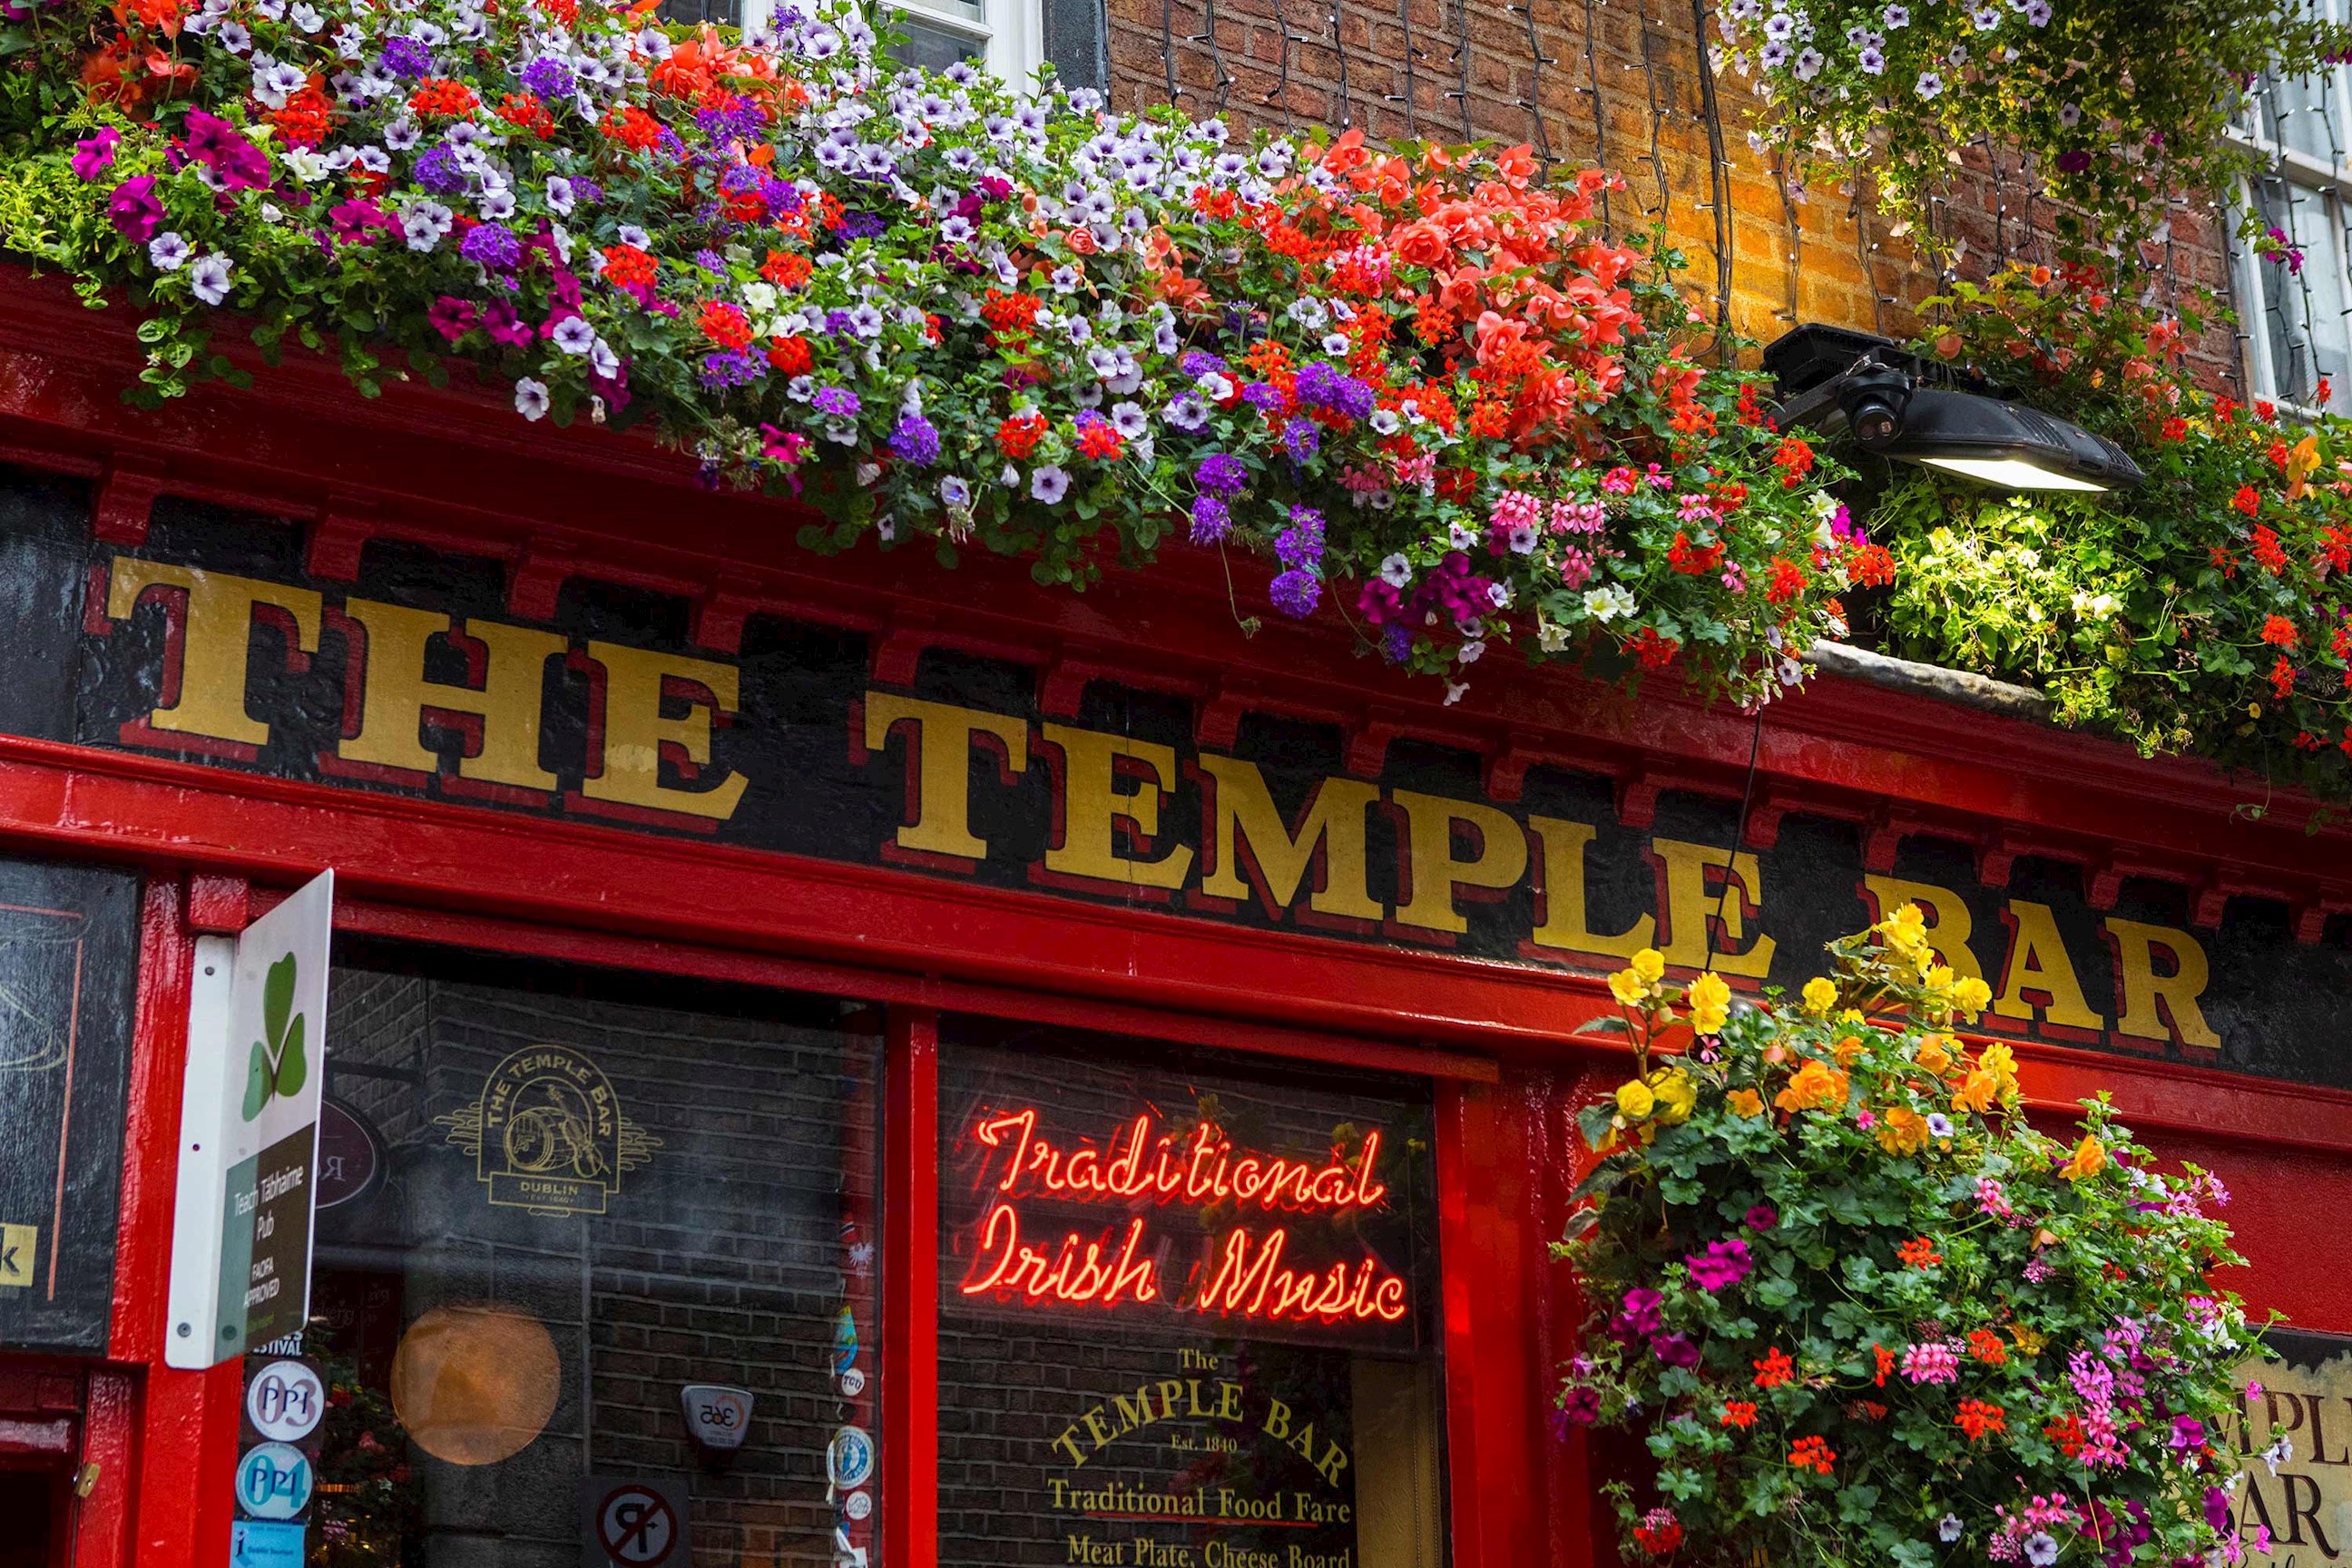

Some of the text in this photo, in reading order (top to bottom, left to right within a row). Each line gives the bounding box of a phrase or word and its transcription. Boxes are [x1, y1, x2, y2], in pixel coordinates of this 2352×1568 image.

[108, 555, 2221, 1049] THE TEMPLE BAR
[486, 1054, 612, 1137] THE TEMPLE BAR
[976, 1109, 1385, 1207] Traditional
[234, 1182, 259, 1217] Teach
[520, 1181, 579, 1196] DUBLIN
[256, 1210, 276, 1241] Pub
[963, 1205, 1406, 1321] Irish Music
[243, 1278, 280, 1309] APPROVED
[1179, 1348, 1220, 1370] The
[842, 1374, 863, 1390] TCU
[1052, 1378, 1348, 1489] TEMPLE BAR
[1171, 1434, 1239, 1453] Est. 1840
[2210, 1387, 2352, 1466] MPL
[1047, 1478, 1351, 1524] Traditional Food Fare
[2214, 1470, 2339, 1561] AR
[1066, 1534, 1350, 1568] Meat Plate, Cheese Board
